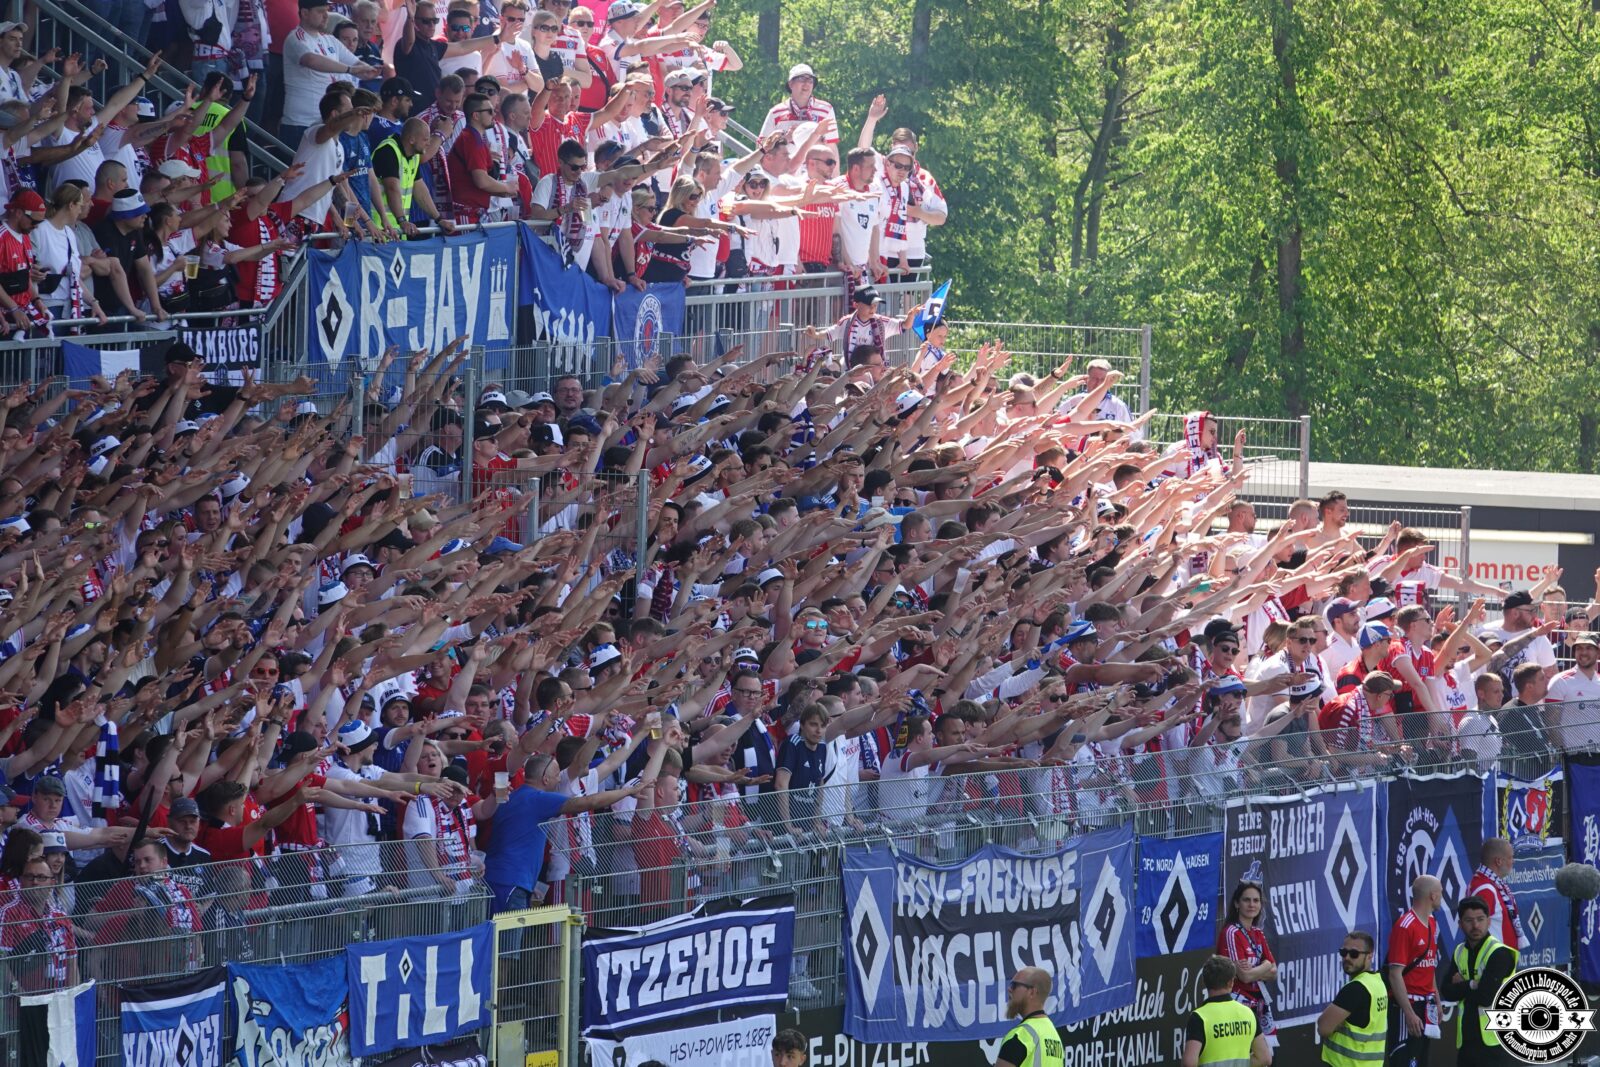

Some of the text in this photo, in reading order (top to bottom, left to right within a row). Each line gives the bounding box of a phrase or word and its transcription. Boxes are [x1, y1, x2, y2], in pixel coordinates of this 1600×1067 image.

[817, 206, 836, 218] HSV
[183, 327, 259, 364] HAMBURG
[1237, 811, 1263, 832] EINE
[1269, 801, 1326, 859] BLAUER
[1230, 834, 1267, 857] REGION
[1156, 858, 1174, 872] NORD
[1185, 853, 1210, 870] HAUSEN
[897, 850, 1077, 920] HSV-FREUNDE
[1141, 904, 1152, 925] 19
[1269, 879, 1320, 936] STERN
[597, 923, 777, 1016] ITZEHOE
[1542, 947, 1557, 964] HSV
[1277, 952, 1347, 1012] SCHAUMB
[669, 1026, 772, 1063] HSV-POWER 1887
[1213, 1020, 1253, 1040] SECURITY
